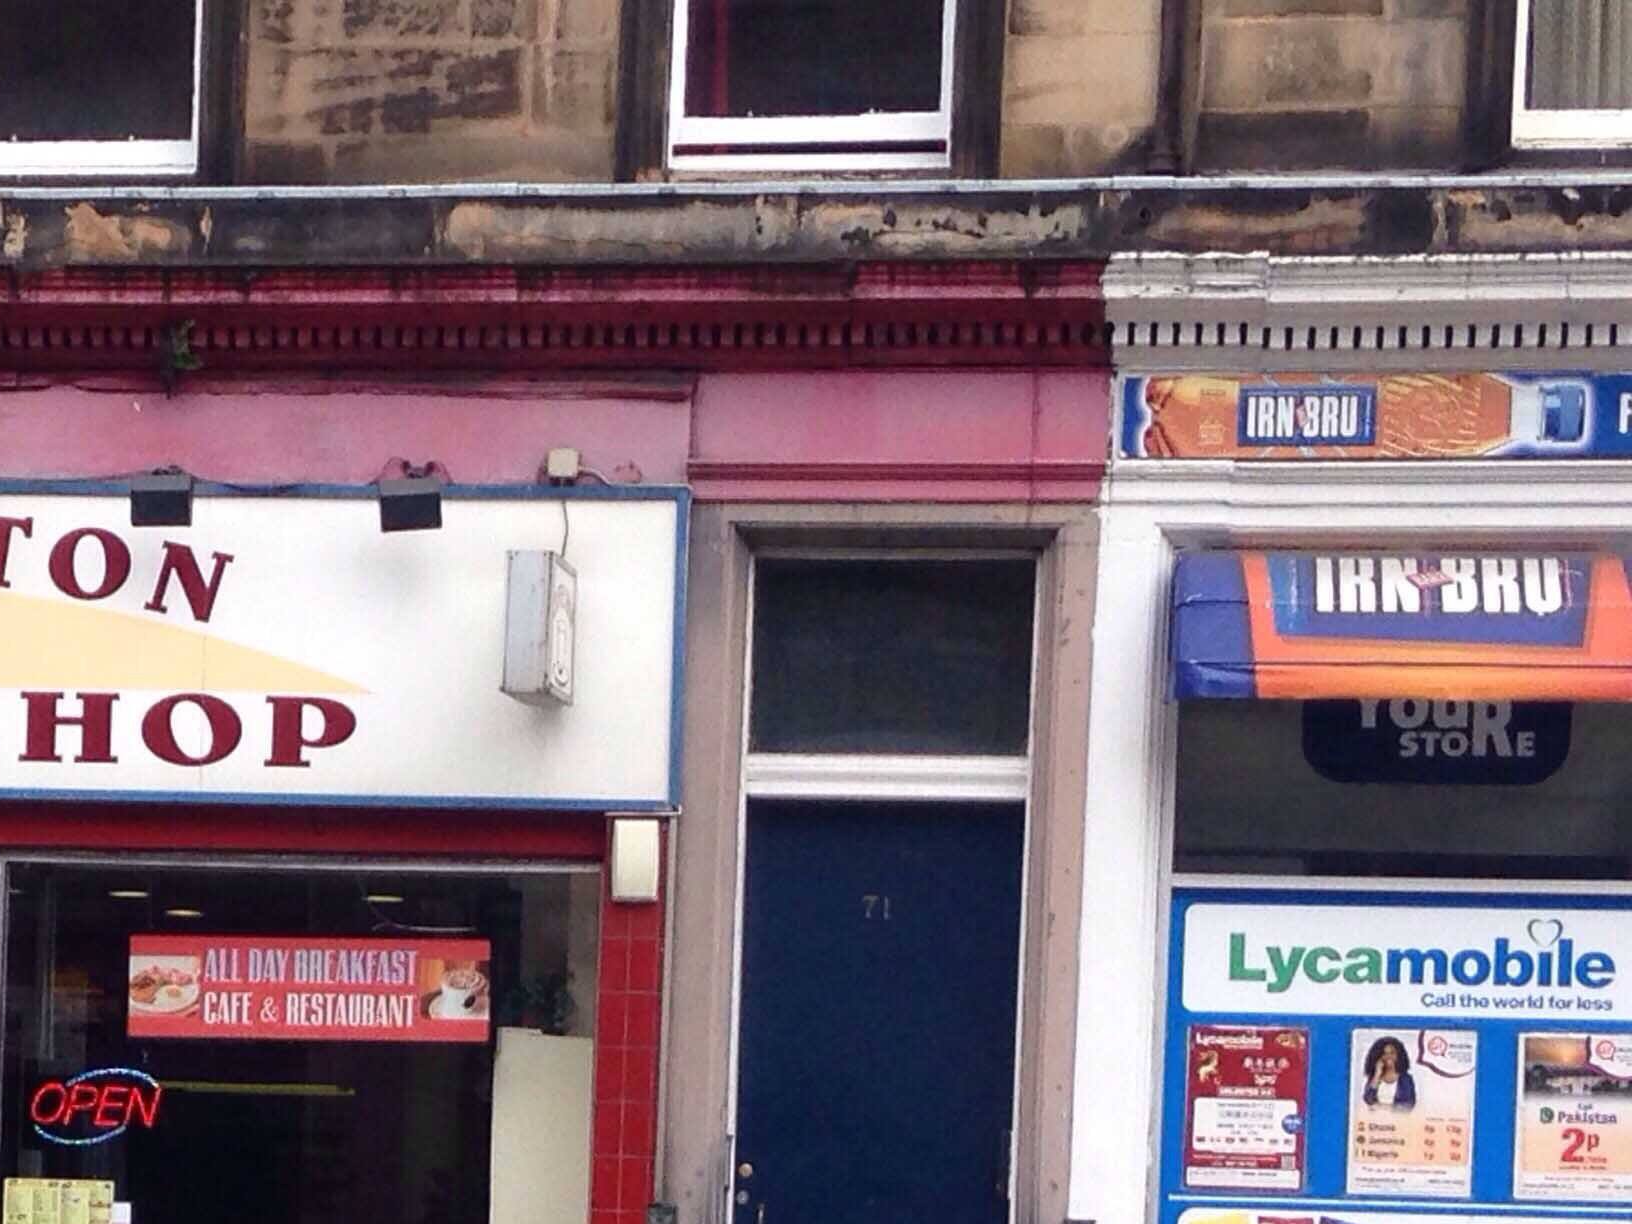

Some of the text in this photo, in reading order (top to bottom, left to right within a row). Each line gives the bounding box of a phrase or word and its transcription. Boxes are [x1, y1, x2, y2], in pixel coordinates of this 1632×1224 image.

[862, 895, 891, 920] 71
[202, 948, 417, 986] ALL DAY BREAKFAST
[1229, 928, 1616, 993] Lycamobile
[203, 991, 417, 1028] CAFE & RESTAURANT
[1420, 992, 1455, 1008] Call
[1460, 993, 1490, 1009] the
[1492, 994, 1543, 1010] world
[30, 1081, 162, 1129] OPEN
